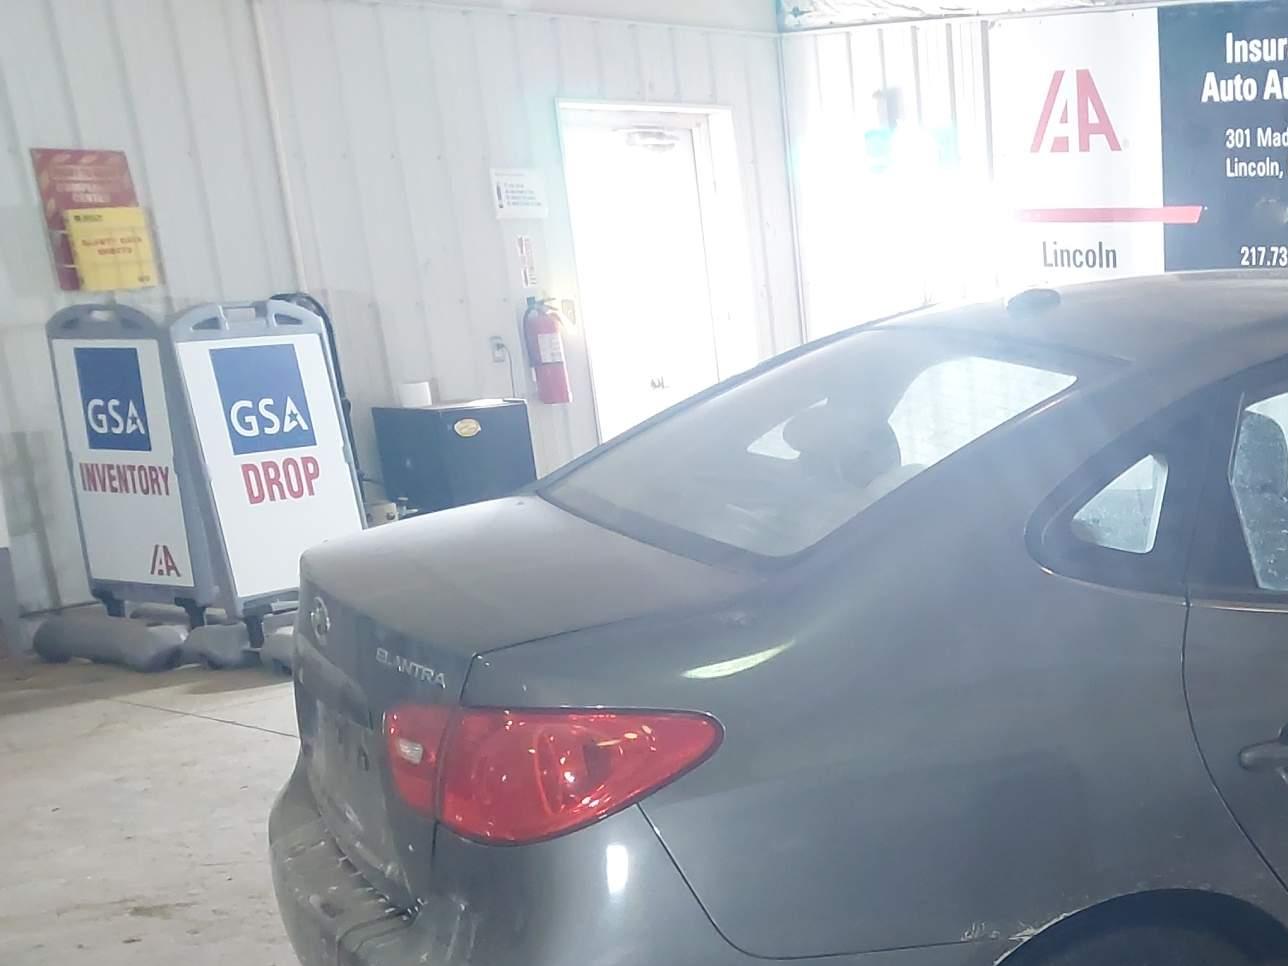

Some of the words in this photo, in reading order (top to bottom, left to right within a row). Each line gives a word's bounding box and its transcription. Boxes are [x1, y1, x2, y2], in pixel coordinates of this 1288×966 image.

[1201, 70, 1258, 103] Auto
[1225, 128, 1251, 149] 301
[1226, 158, 1284, 179] Lincoln,
[1043, 241, 1118, 269] Lincoln
[87, 397, 146, 435] GSA
[229, 396, 309, 438] GSA
[79, 461, 170, 497] INVENTORY
[241, 456, 321, 505] DROP
